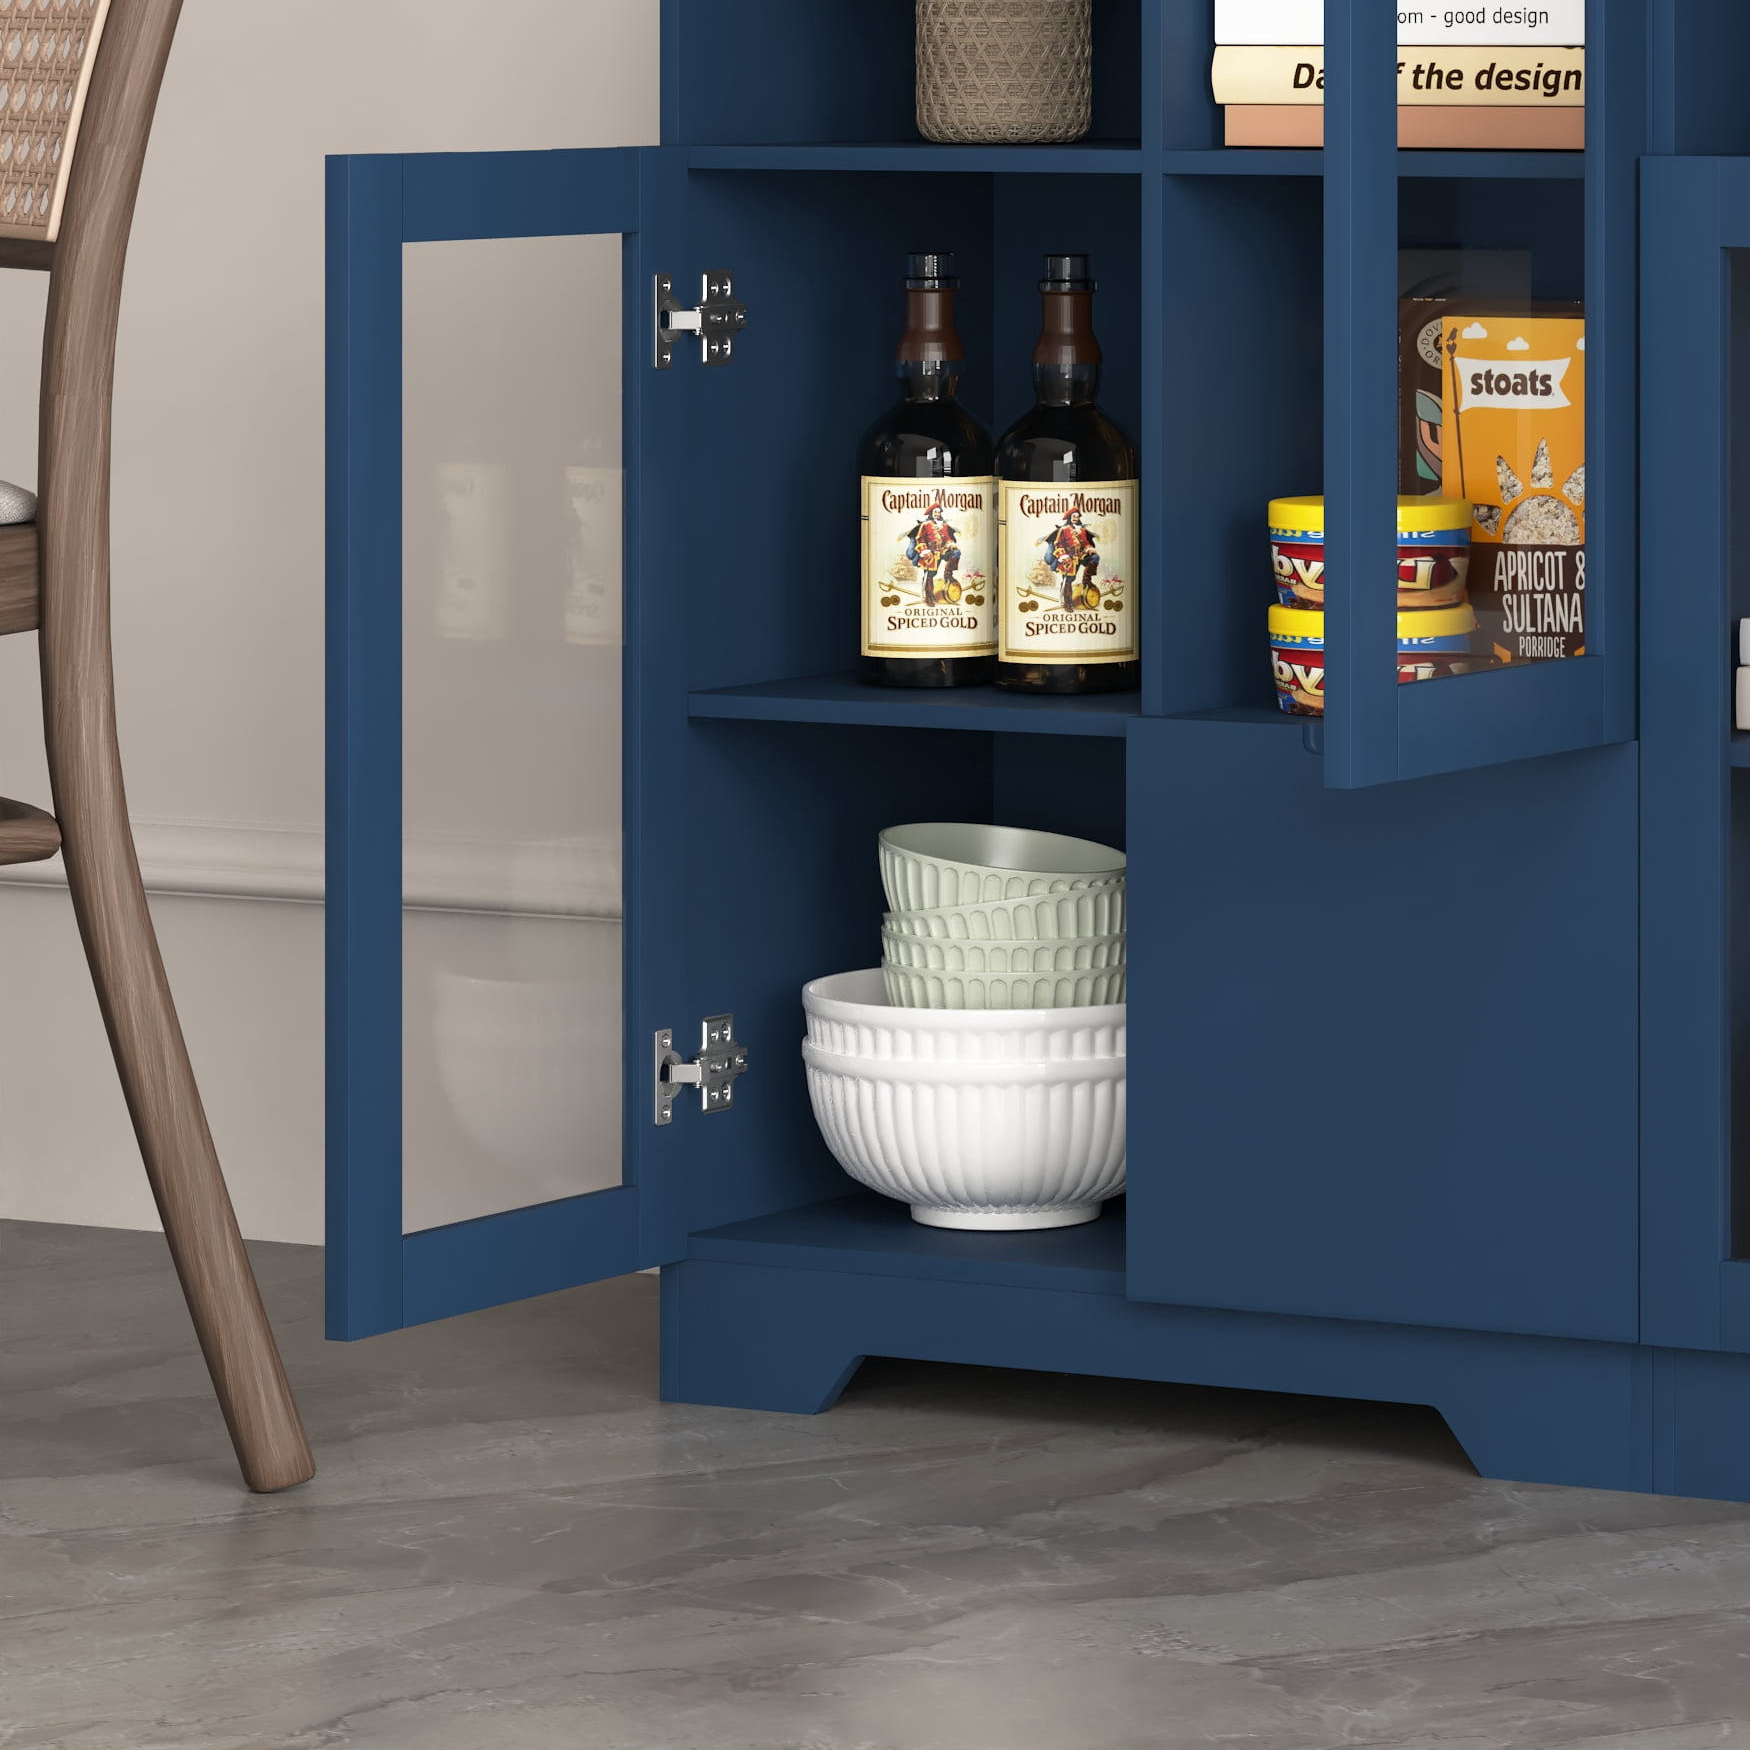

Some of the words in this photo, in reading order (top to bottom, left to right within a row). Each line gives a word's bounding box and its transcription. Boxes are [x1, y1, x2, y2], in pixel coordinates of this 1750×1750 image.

[1444, 7, 1485, 27] good
[1492, 7, 1549, 27] design
[1412, 62, 1464, 90] the
[1475, 62, 1582, 97] design
[1470, 368, 1552, 396] stoats
[881, 490, 931, 514] Captain
[931, 488, 983, 512] Morgan
[1019, 493, 1069, 518] Captain
[1069, 493, 1121, 517] Morgan
[1494, 550, 1567, 591] APRICOT
[904, 607, 963, 616] ORIGINAL
[1043, 613, 1102, 622] ORIGINAL
[1502, 593, 1584, 633] SULTANA
[887, 616, 938, 631] SPICED
[940, 616, 978, 629] GOLD
[1025, 621, 1076, 636] SPICED
[1078, 621, 1116, 635] GOLD
[1519, 636, 1566, 658] PORRIDGE
